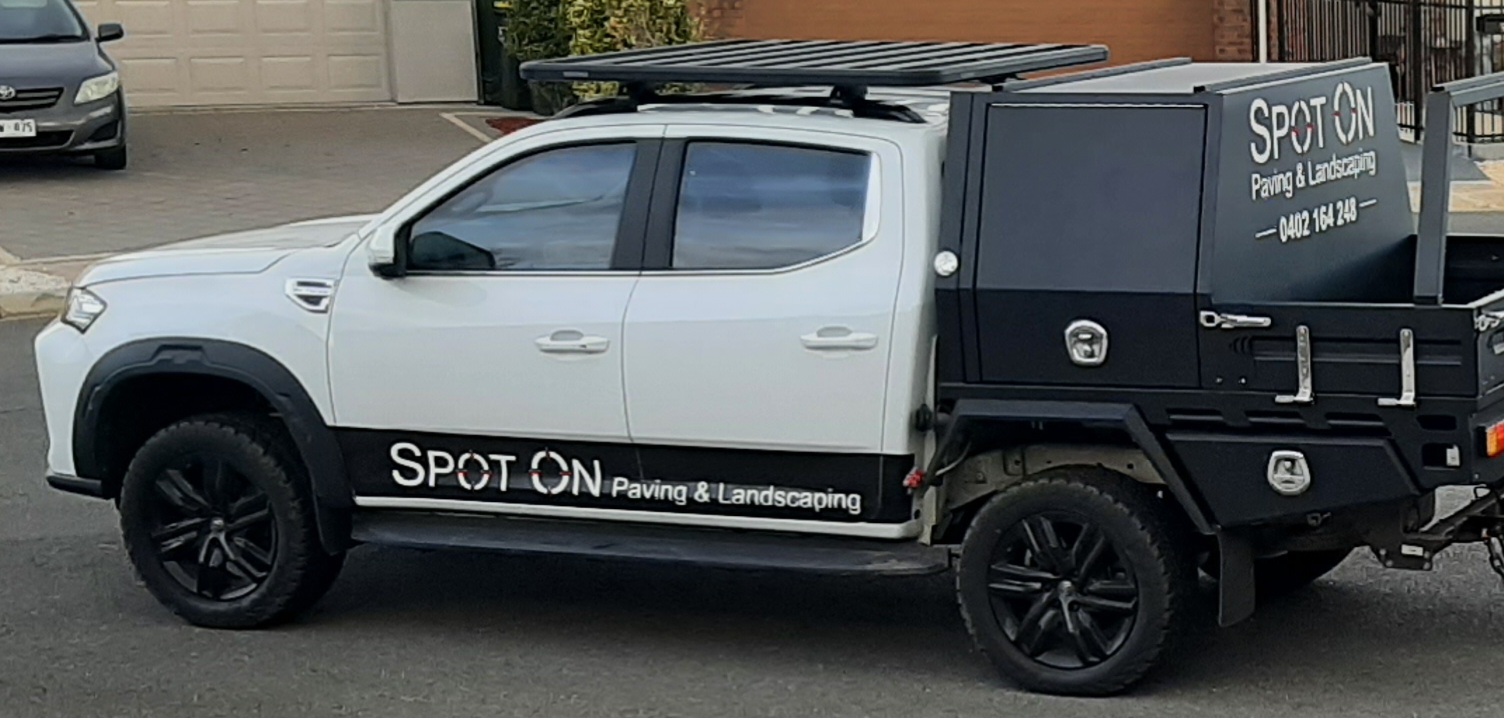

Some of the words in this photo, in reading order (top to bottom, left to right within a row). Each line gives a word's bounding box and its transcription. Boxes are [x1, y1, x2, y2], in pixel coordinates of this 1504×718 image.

[1333, 81, 1375, 145] ON
[1251, 168, 1293, 200] Paving
[1296, 163, 1306, 188] &
[1308, 147, 1376, 186] Landscaping
[1279, 210, 1311, 243] 0402
[1313, 203, 1334, 233] 164
[1337, 197, 1357, 226] 248
[530, 448, 601, 497] ON
[611, 476, 688, 505] Paving
[694, 481, 710, 502] &
[717, 482, 862, 515] Landscaping
